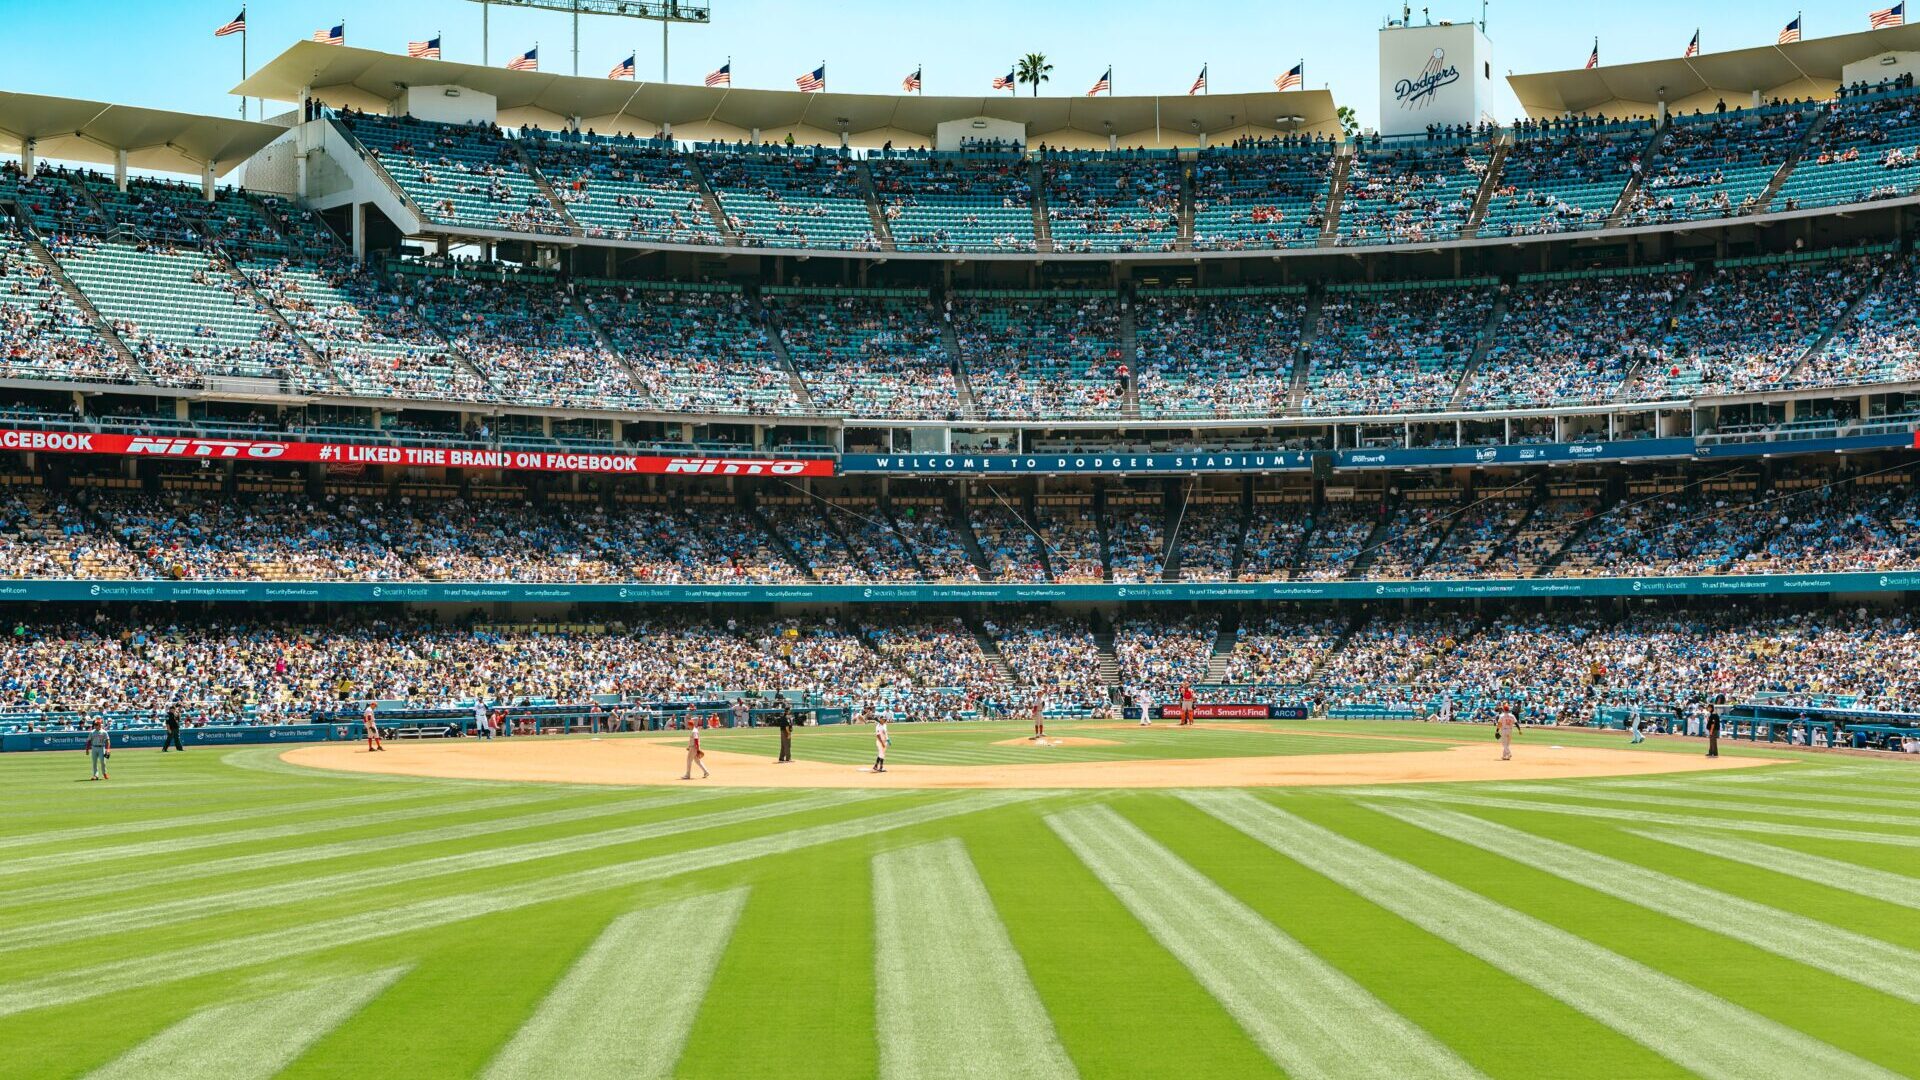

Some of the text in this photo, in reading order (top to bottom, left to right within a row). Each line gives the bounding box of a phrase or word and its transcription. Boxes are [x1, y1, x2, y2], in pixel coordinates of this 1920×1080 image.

[1395, 65, 1460, 101] Dodgers
[126, 438, 285, 458] NITTO
[319, 445, 637, 471] #1 LIKED TIRE BRAND ON FACEBOOK
[877, 456, 1284, 468] WELCOME TO DODGER STADIUM
[665, 458, 805, 475] NITTO
[1641, 582, 1688, 591] Security Benefit
[1888, 578, 1909, 586] Security
[100, 586, 153, 595] Security Benefit
[381, 588, 428, 598] Security Benefit
[627, 589, 672, 598] Security Benefit
[872, 589, 917, 599] Security Benefit
[1126, 588, 1173, 598] Security Benefit
[1385, 585, 1431, 595] Security Benefit
[51, 737, 73, 745] Security
